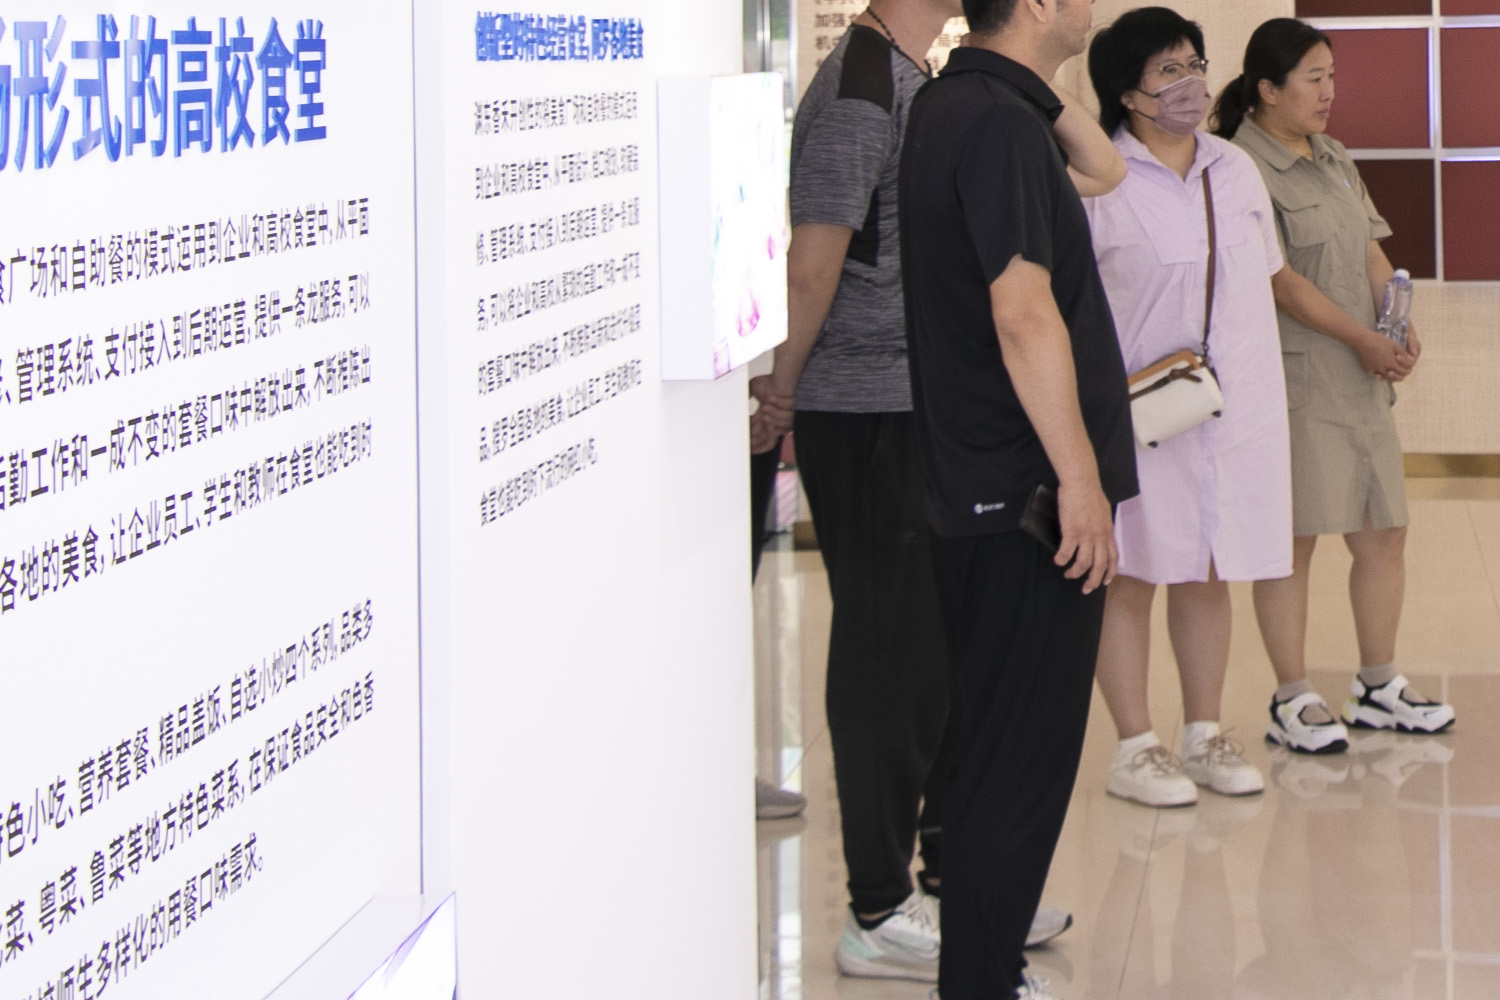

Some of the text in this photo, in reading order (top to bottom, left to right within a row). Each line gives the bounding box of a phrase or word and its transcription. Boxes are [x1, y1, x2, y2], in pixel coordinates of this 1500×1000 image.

[0, 270, 371, 405] 、管理系统、支付接入到后期运营，提供一条龙服务，可以
[0, 597, 374, 864] 色小吃、营养套餐、精品盖饭、自选小炒四个系列，品类多
[0, 670, 374, 968] 菜、粤菜、鲁菜等地方特色菜系，在保证食品安全和色香
[22, 832, 264, 1000] 师生多样化的用餐口味需求。
